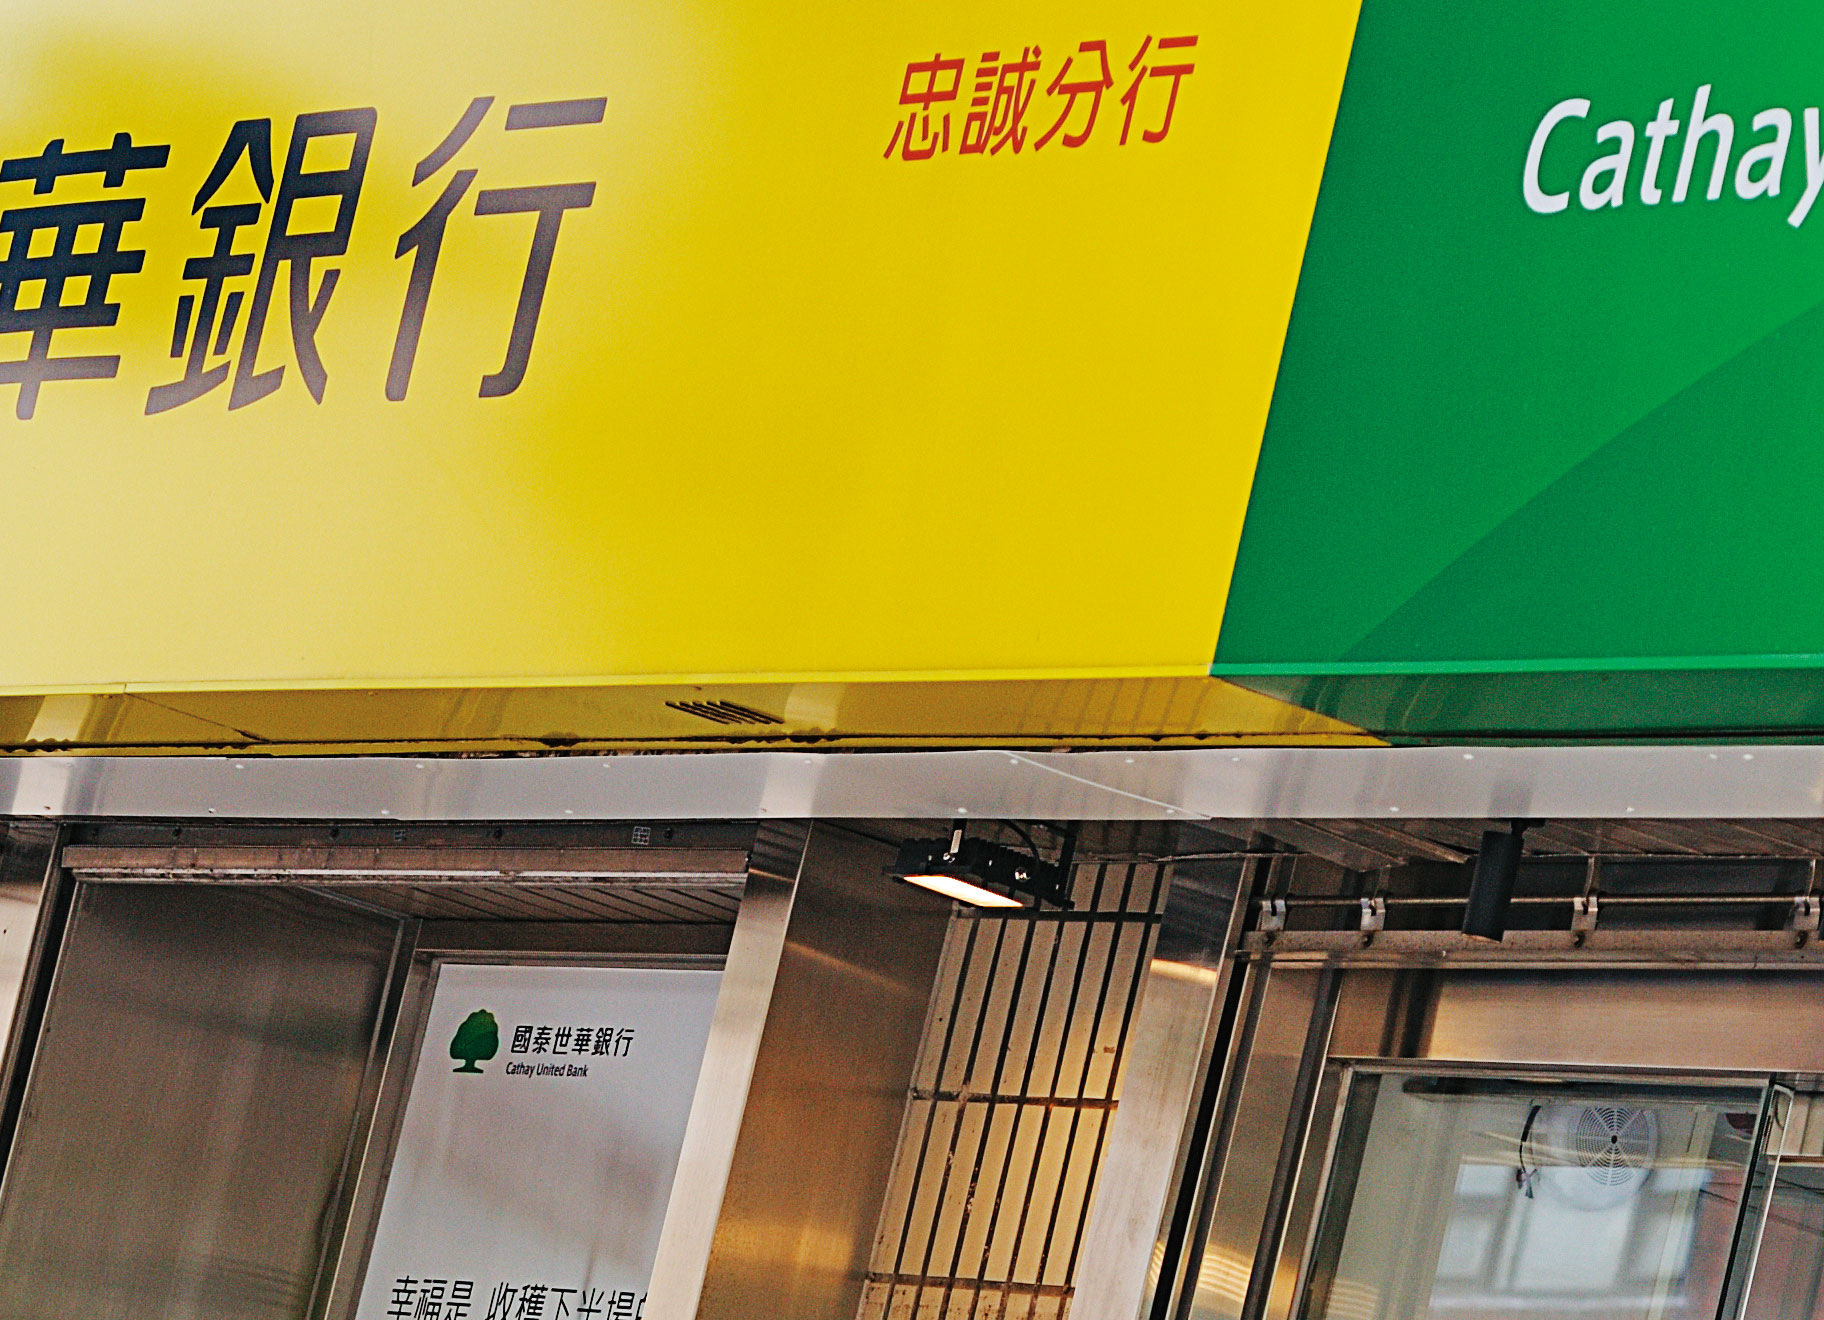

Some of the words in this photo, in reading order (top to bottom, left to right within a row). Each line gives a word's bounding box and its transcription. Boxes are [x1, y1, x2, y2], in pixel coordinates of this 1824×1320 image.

[883, 34, 1199, 163] 忠誠分行
[1521, 83, 1824, 229] Cathay
[506, 1061, 535, 1079] Cathay
[536, 1063, 566, 1077] United
[566, 1064, 589, 1077] Bank
[511, 1025, 635, 1057] 國泰世華銀行
